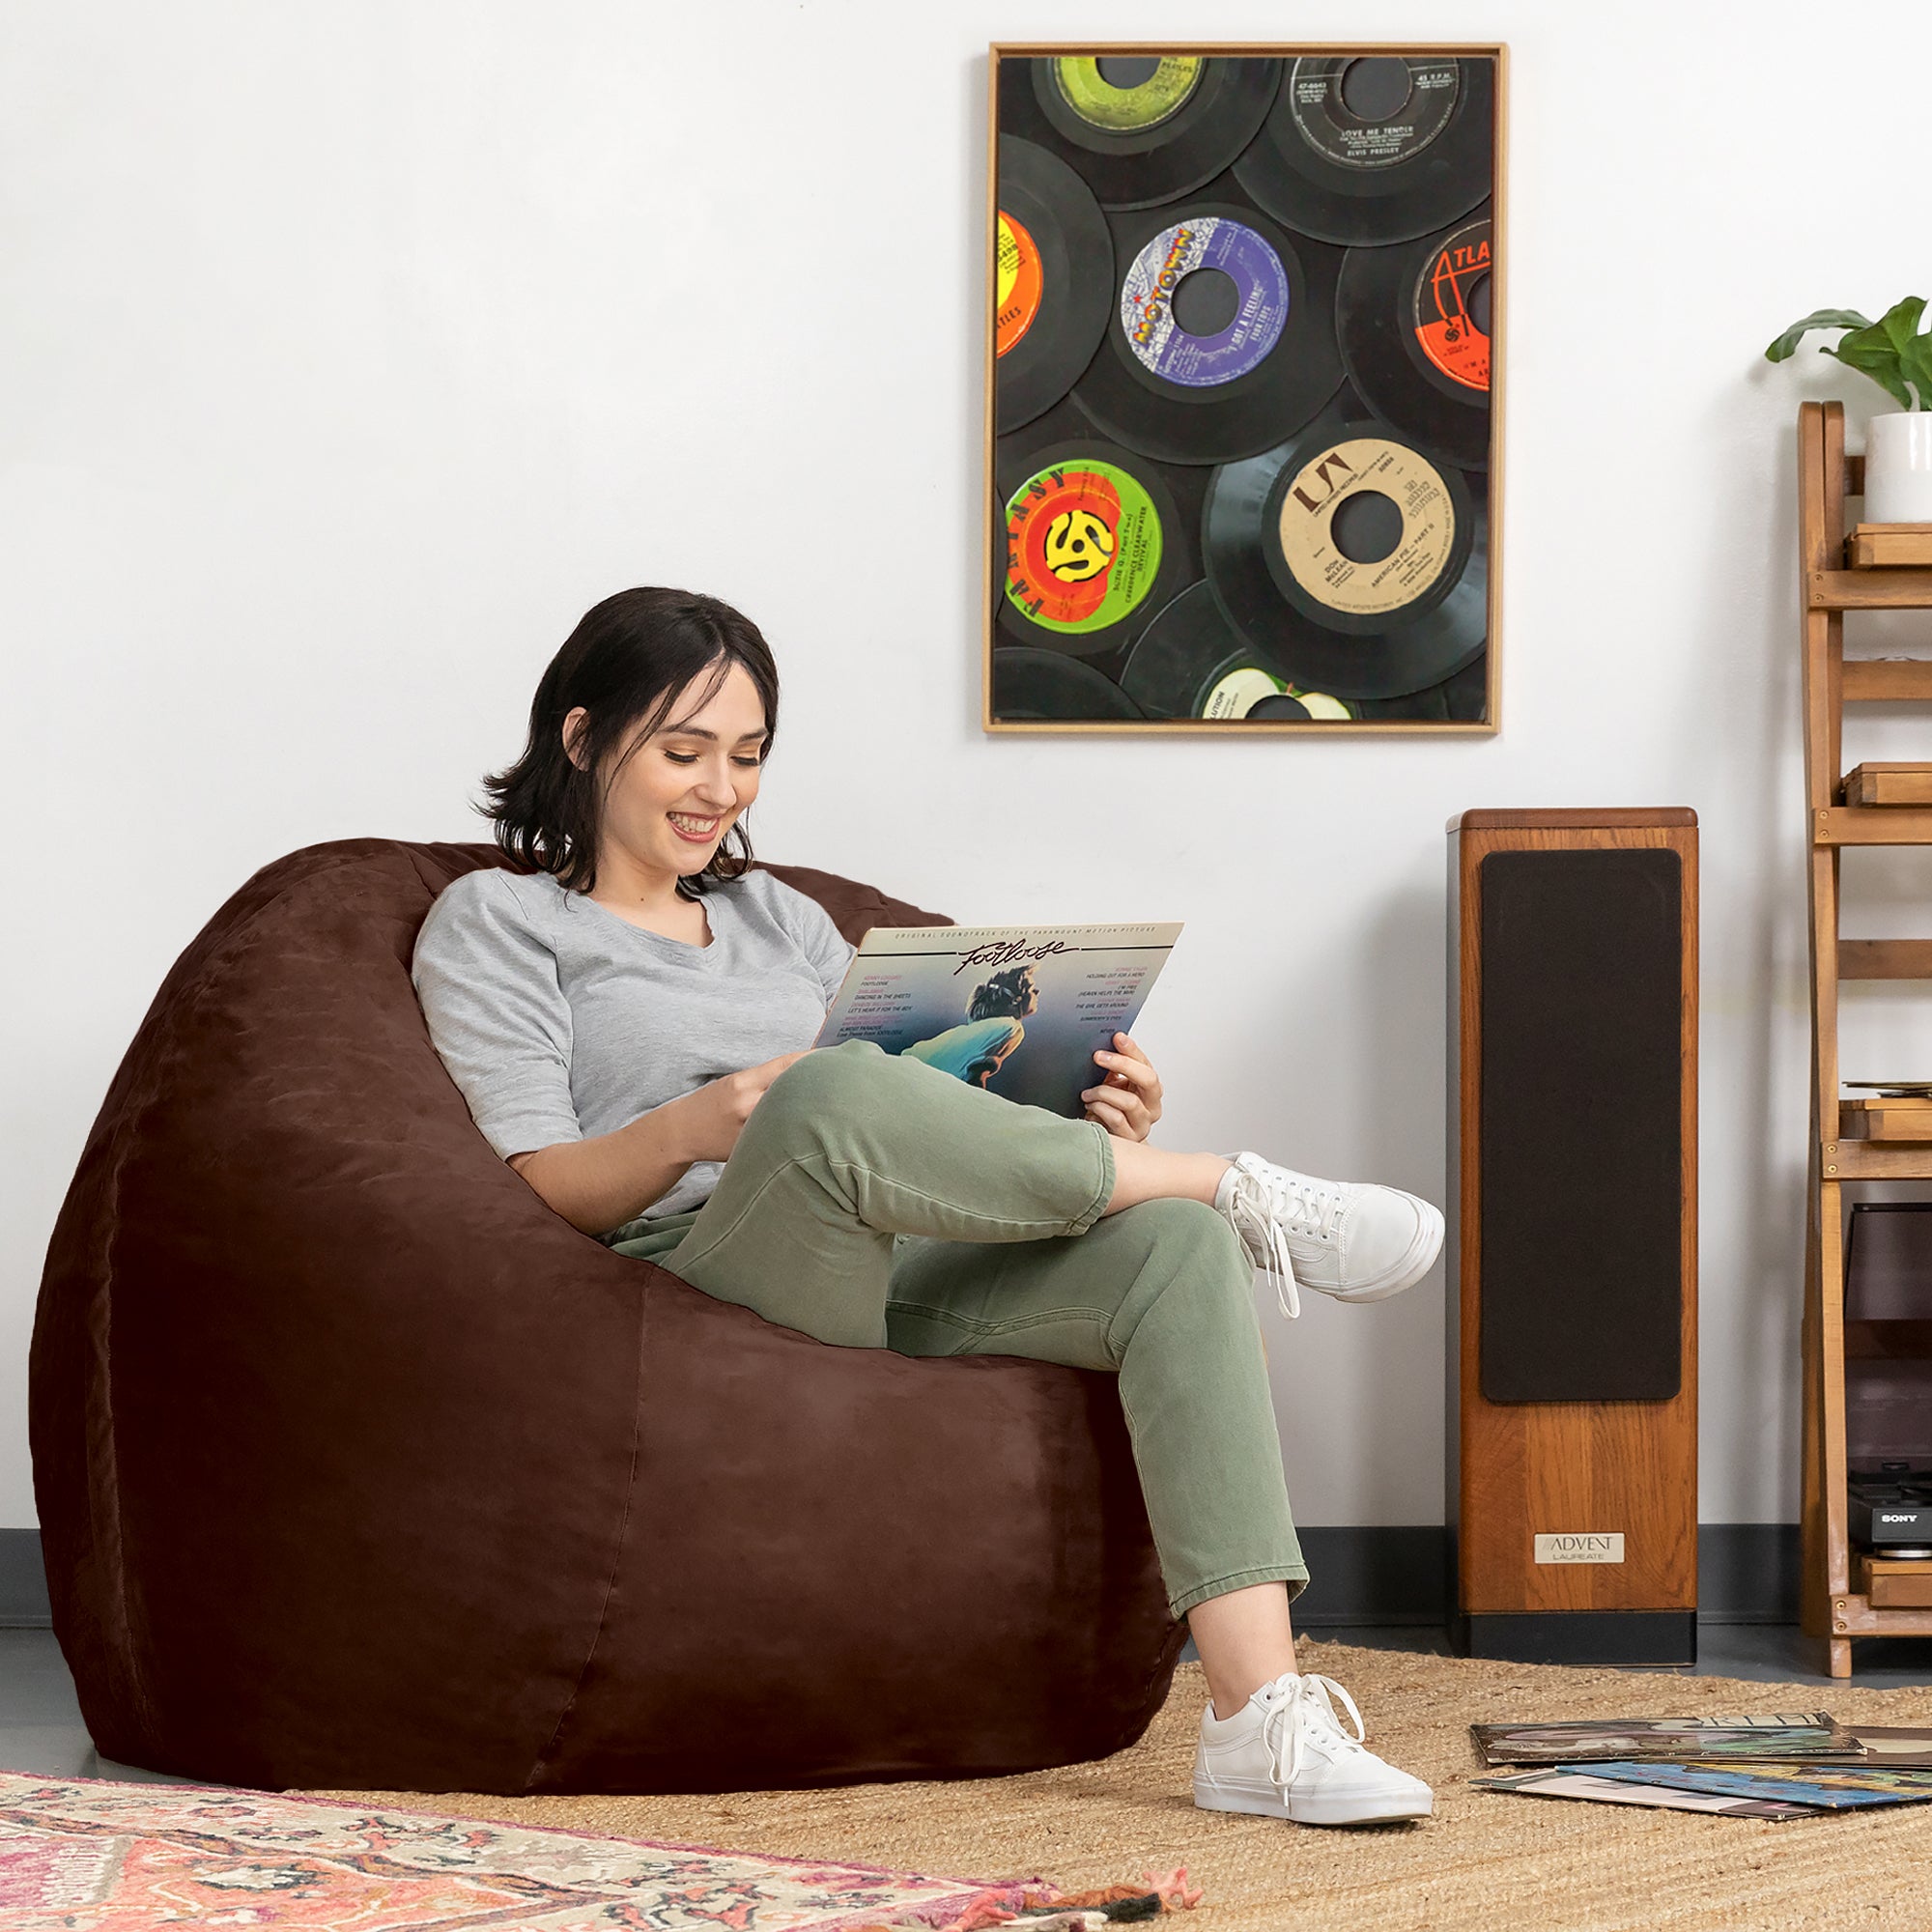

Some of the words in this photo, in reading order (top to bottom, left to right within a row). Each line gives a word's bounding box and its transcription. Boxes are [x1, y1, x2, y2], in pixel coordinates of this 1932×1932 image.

[1342, 129, 1362, 138] LOVE
[1133, 228, 1196, 348] MOTOWN
[1323, 558, 1339, 573] DON
[1371, 558, 1400, 587] AMERICAN
[1398, 547, 1410, 559] PIE
[1412, 527, 1430, 545] PART
[953, 938, 1080, 976] Footloose
[1550, 1537, 1613, 1550] ADVENT
